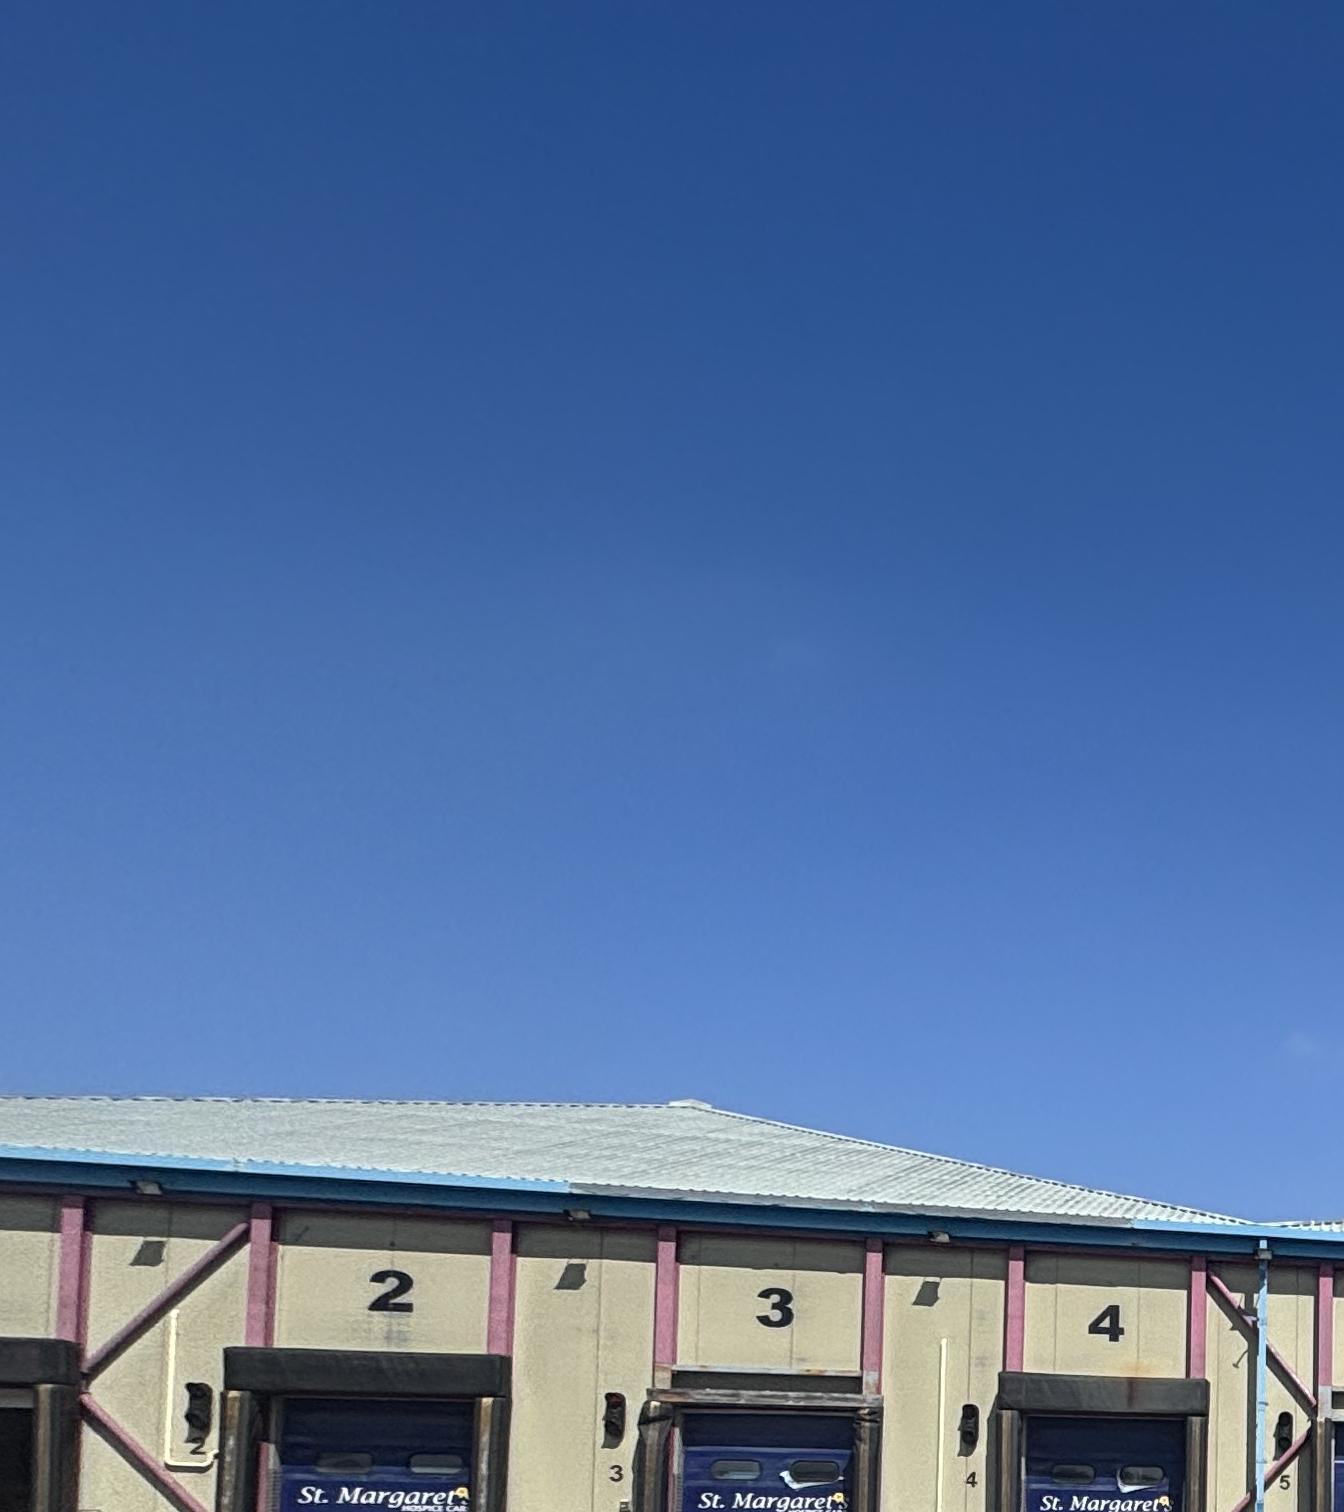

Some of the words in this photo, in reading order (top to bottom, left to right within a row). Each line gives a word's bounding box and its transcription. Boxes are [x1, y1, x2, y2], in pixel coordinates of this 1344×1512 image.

[367, 1269, 414, 1313] 2
[756, 1287, 794, 1328] 3
[1088, 1304, 1125, 1343] 4
[189, 1437, 207, 1456] 2
[609, 1464, 624, 1482] 3
[965, 1471, 978, 1488] 4
[1279, 1474, 1291, 1491] 5
[297, 1486, 329, 1504] St.
[698, 1492, 726, 1509] St.
[1039, 1495, 1064, 1511] St.
